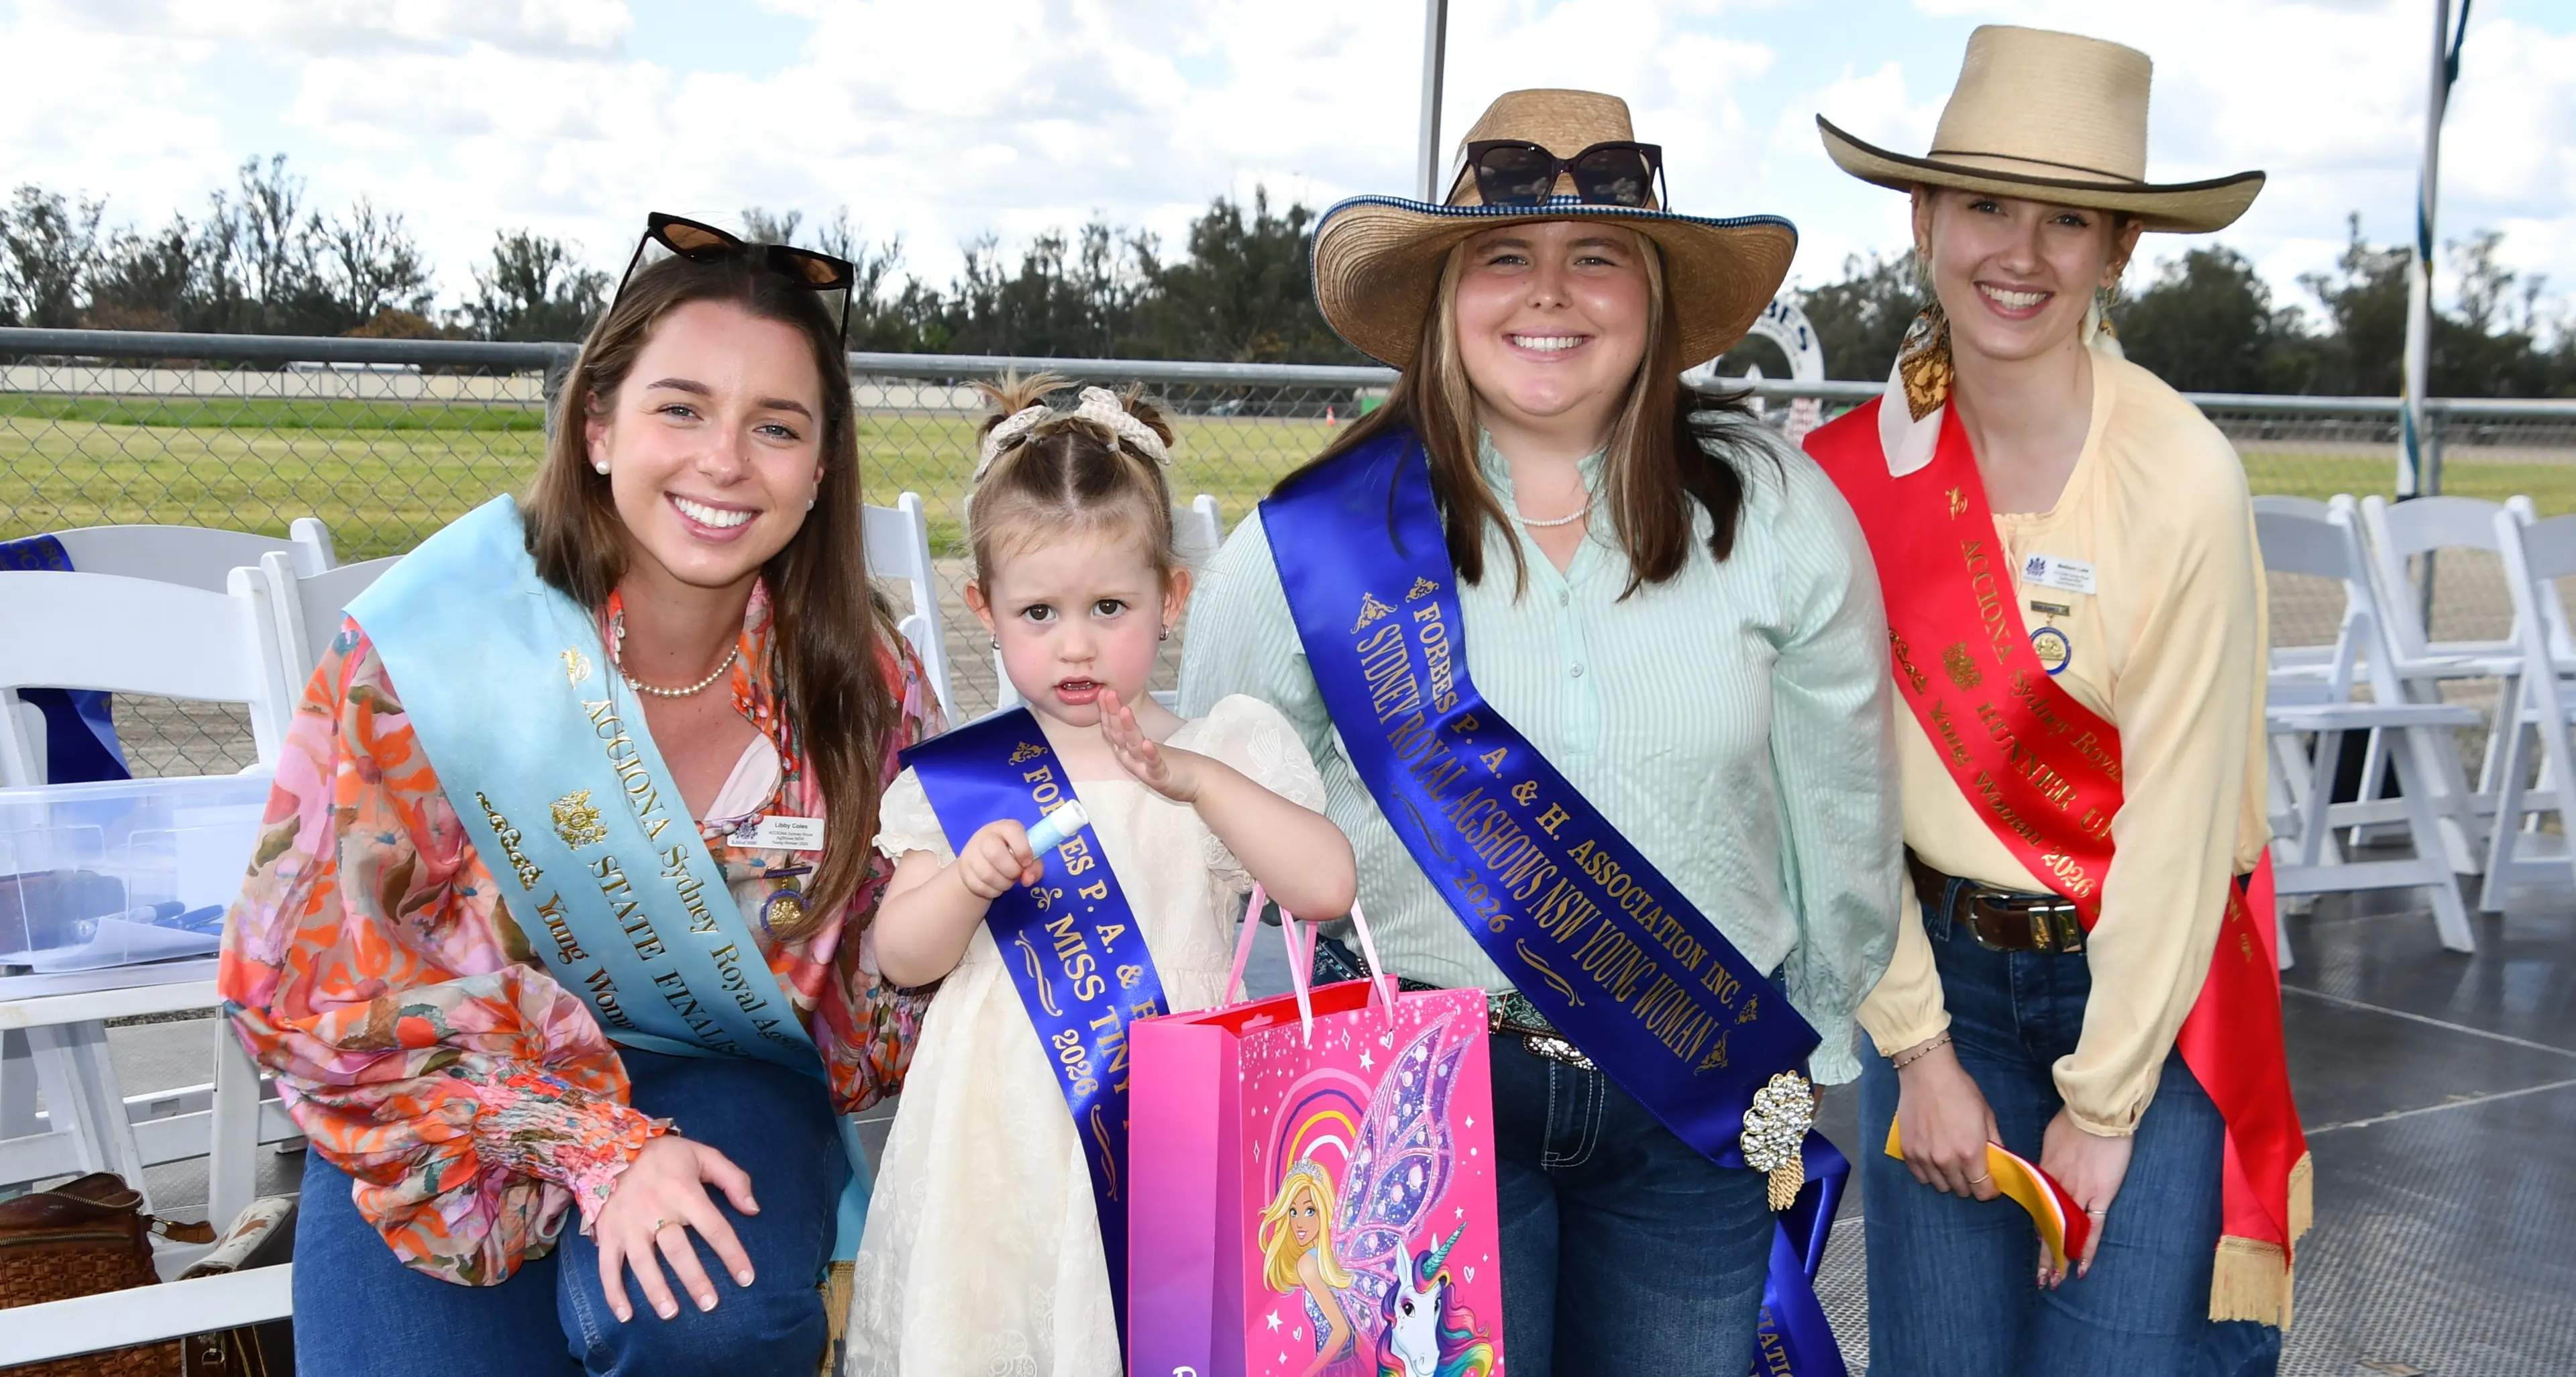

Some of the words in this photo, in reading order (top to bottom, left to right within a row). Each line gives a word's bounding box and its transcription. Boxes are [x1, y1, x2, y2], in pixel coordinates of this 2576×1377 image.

[1356, 623, 1421, 725] SYDNEY
[1960, 539, 2013, 664] ACCIONA
[2008, 668, 2072, 735] Sydney
[2070, 730, 2123, 784] Roya
[1387, 711, 1467, 802] ROYAL
[1411, 602, 1459, 715] FORBES
[1451, 712, 1479, 746] P.
[1479, 747, 1509, 780] A.
[1511, 780, 1538, 807] &
[1535, 803, 1570, 842] H.
[1567, 839, 1706, 973] ASSOCIATION
[1699, 960, 1742, 1011] INC.
[1927, 698, 1973, 768] Young
[1974, 770, 2042, 847] Woman
[2041, 846, 2096, 898] 2026
[1976, 701, 2077, 811] RUNNER
[581, 699, 672, 842] ACCIONA
[660, 844, 719, 934] Sydney
[709, 939, 768, 1014] Royal
[1023, 764, 1095, 876] FOES
[1078, 879, 1108, 913] P.
[1095, 923, 1125, 954] A.
[1116, 964, 1143, 990] &
[1442, 787, 1557, 901] AGSHOWS
[589, 855, 667, 961] STATE
[1452, 868, 1513, 934] 2026
[1526, 865, 1603, 945] NSW
[535, 890, 590, 966] Young
[584, 965, 640, 1031] Wom
[1044, 913, 1106, 1002] MISS
[1571, 918, 1658, 1003] YOUNG
[1052, 1030, 1098, 1096] 2026
[1631, 973, 1720, 1064] WOMAN
